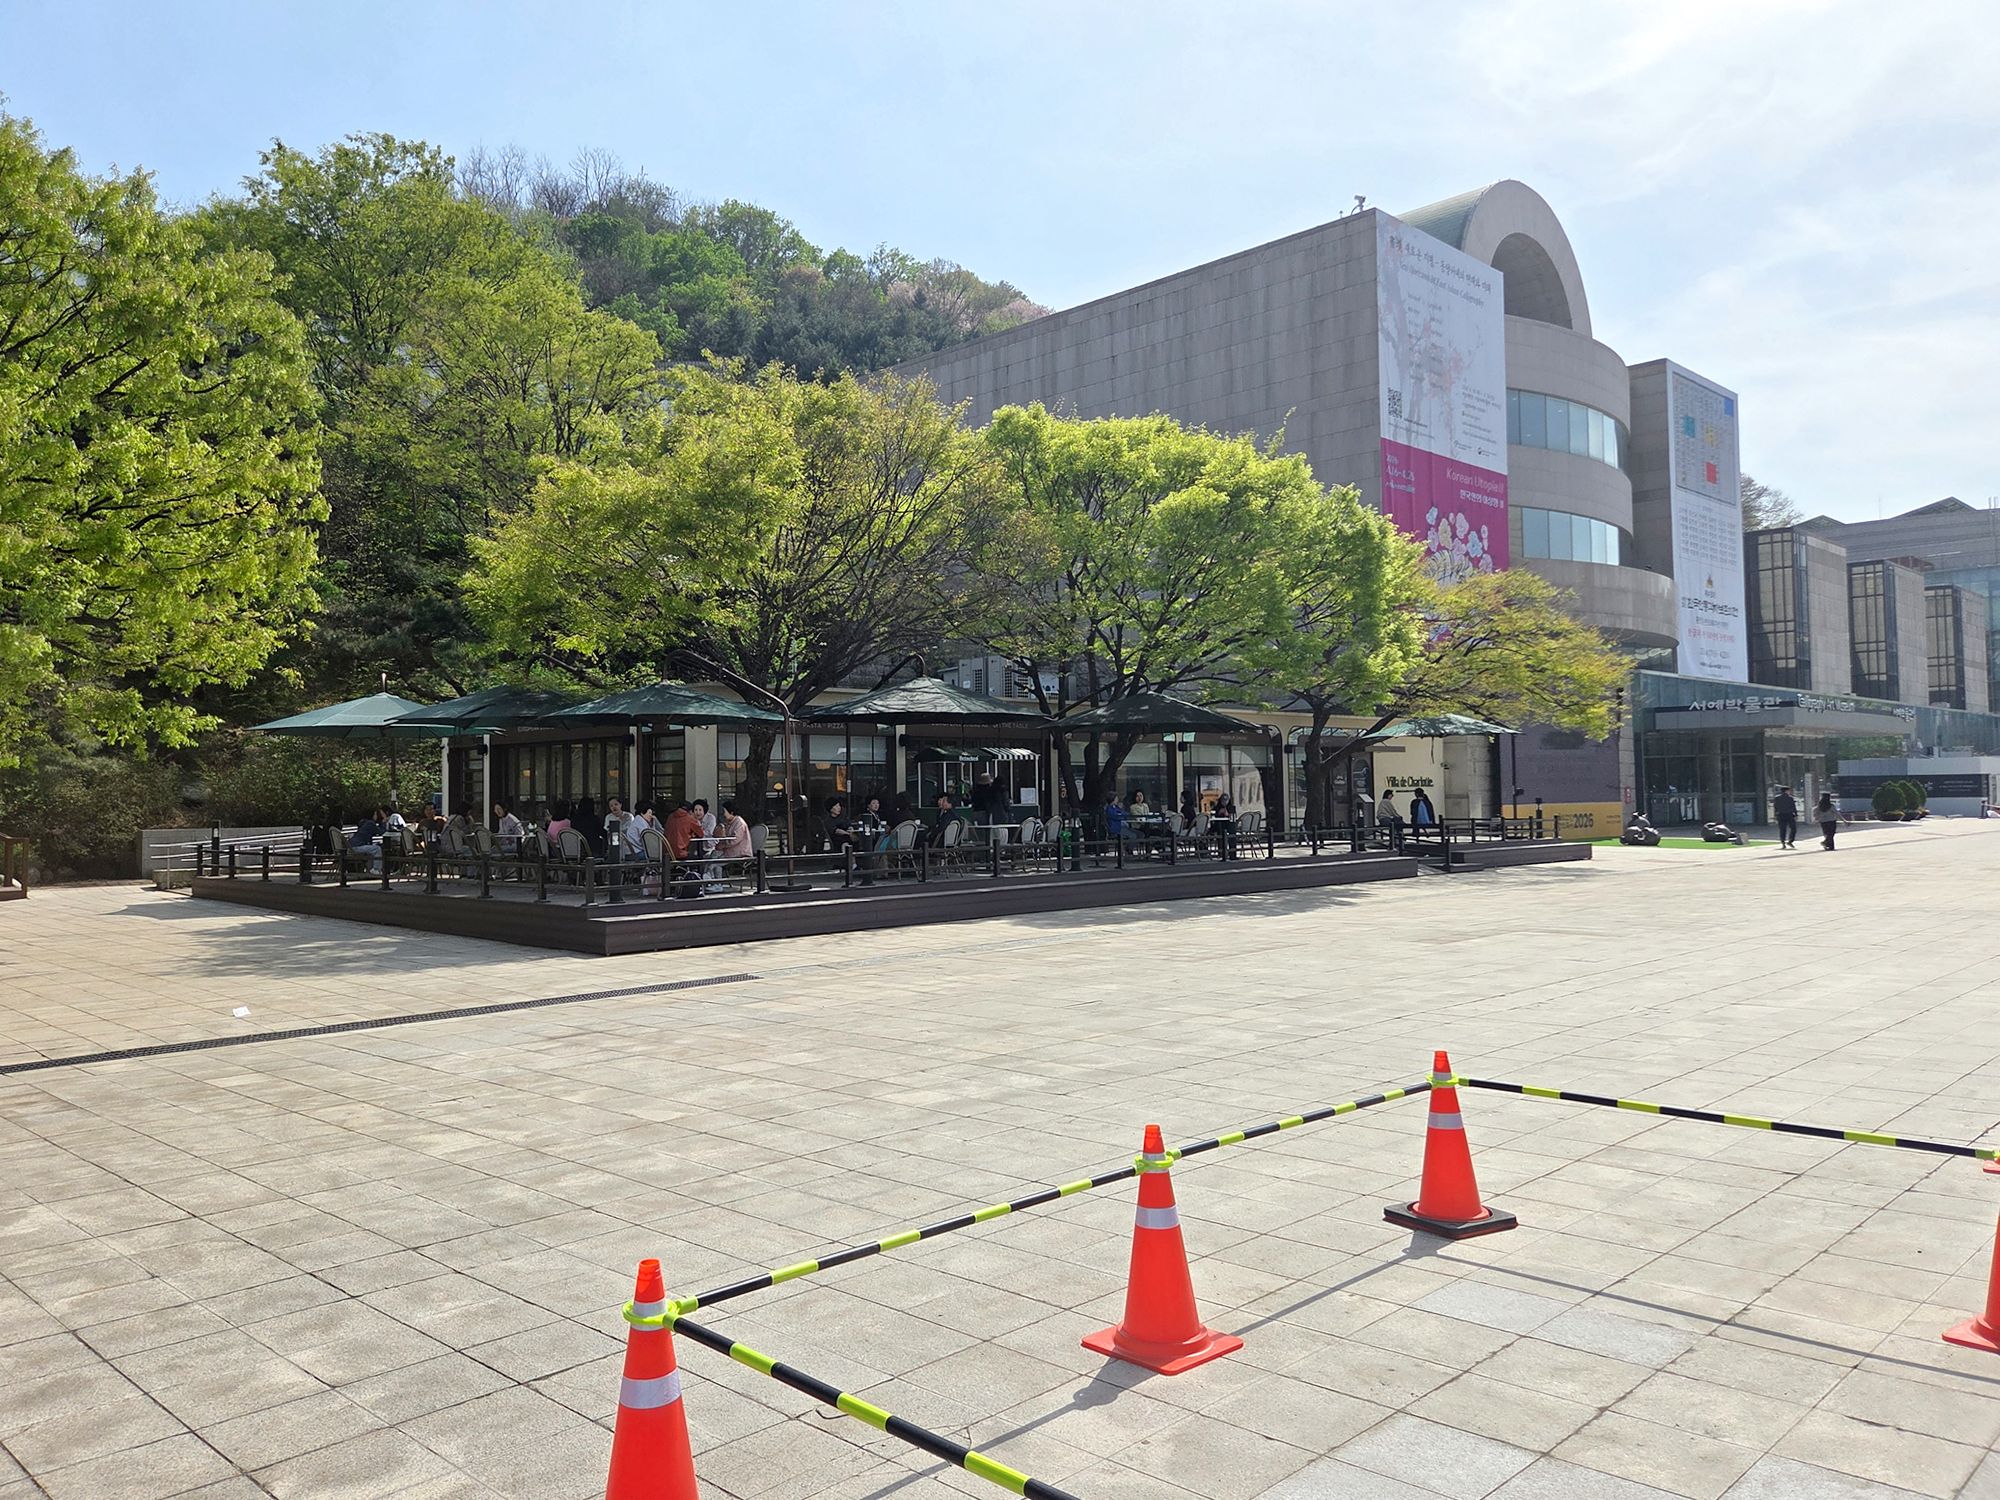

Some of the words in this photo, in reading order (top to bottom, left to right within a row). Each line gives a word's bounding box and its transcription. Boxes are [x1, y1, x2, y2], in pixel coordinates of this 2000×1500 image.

[1446, 467, 1474, 486] Korean
[1474, 475, 1499, 493] Utopia
[1689, 696, 1783, 714] 서예박물관
[1384, 775, 1399, 788] Villa
[1400, 776, 1407, 788] de
[1573, 813, 1594, 828] 2026
